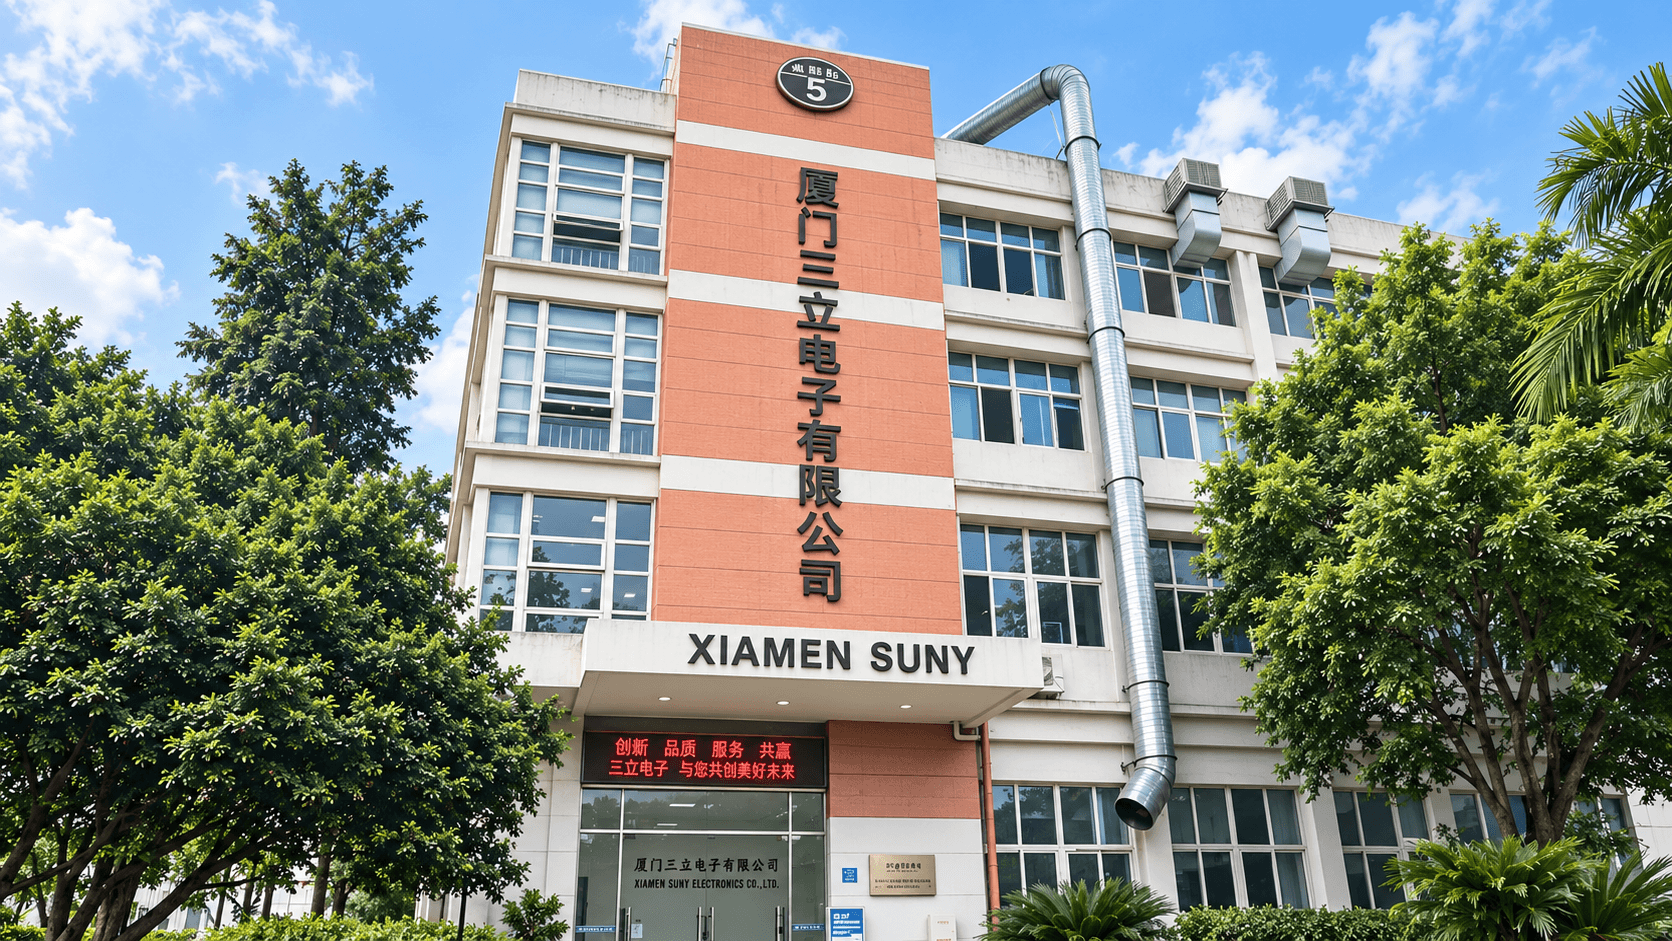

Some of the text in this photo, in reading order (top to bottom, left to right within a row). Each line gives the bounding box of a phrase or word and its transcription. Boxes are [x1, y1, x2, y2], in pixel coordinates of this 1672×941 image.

[806, 77, 827, 102] 5
[796, 166, 844, 603] 厦门三立电子有限公司
[687, 633, 975, 675] XIAMEN SUNY
[615, 737, 792, 760] 创新 品质 服务 共赢
[608, 758, 796, 780] 三立电子 与您共创美好未来
[634, 857, 779, 873] 厦门三立电子有限公司
[634, 878, 666, 889] XIAMEN
[668, 878, 690, 889] SUNY
[692, 878, 744, 889] ELECTRONICS
